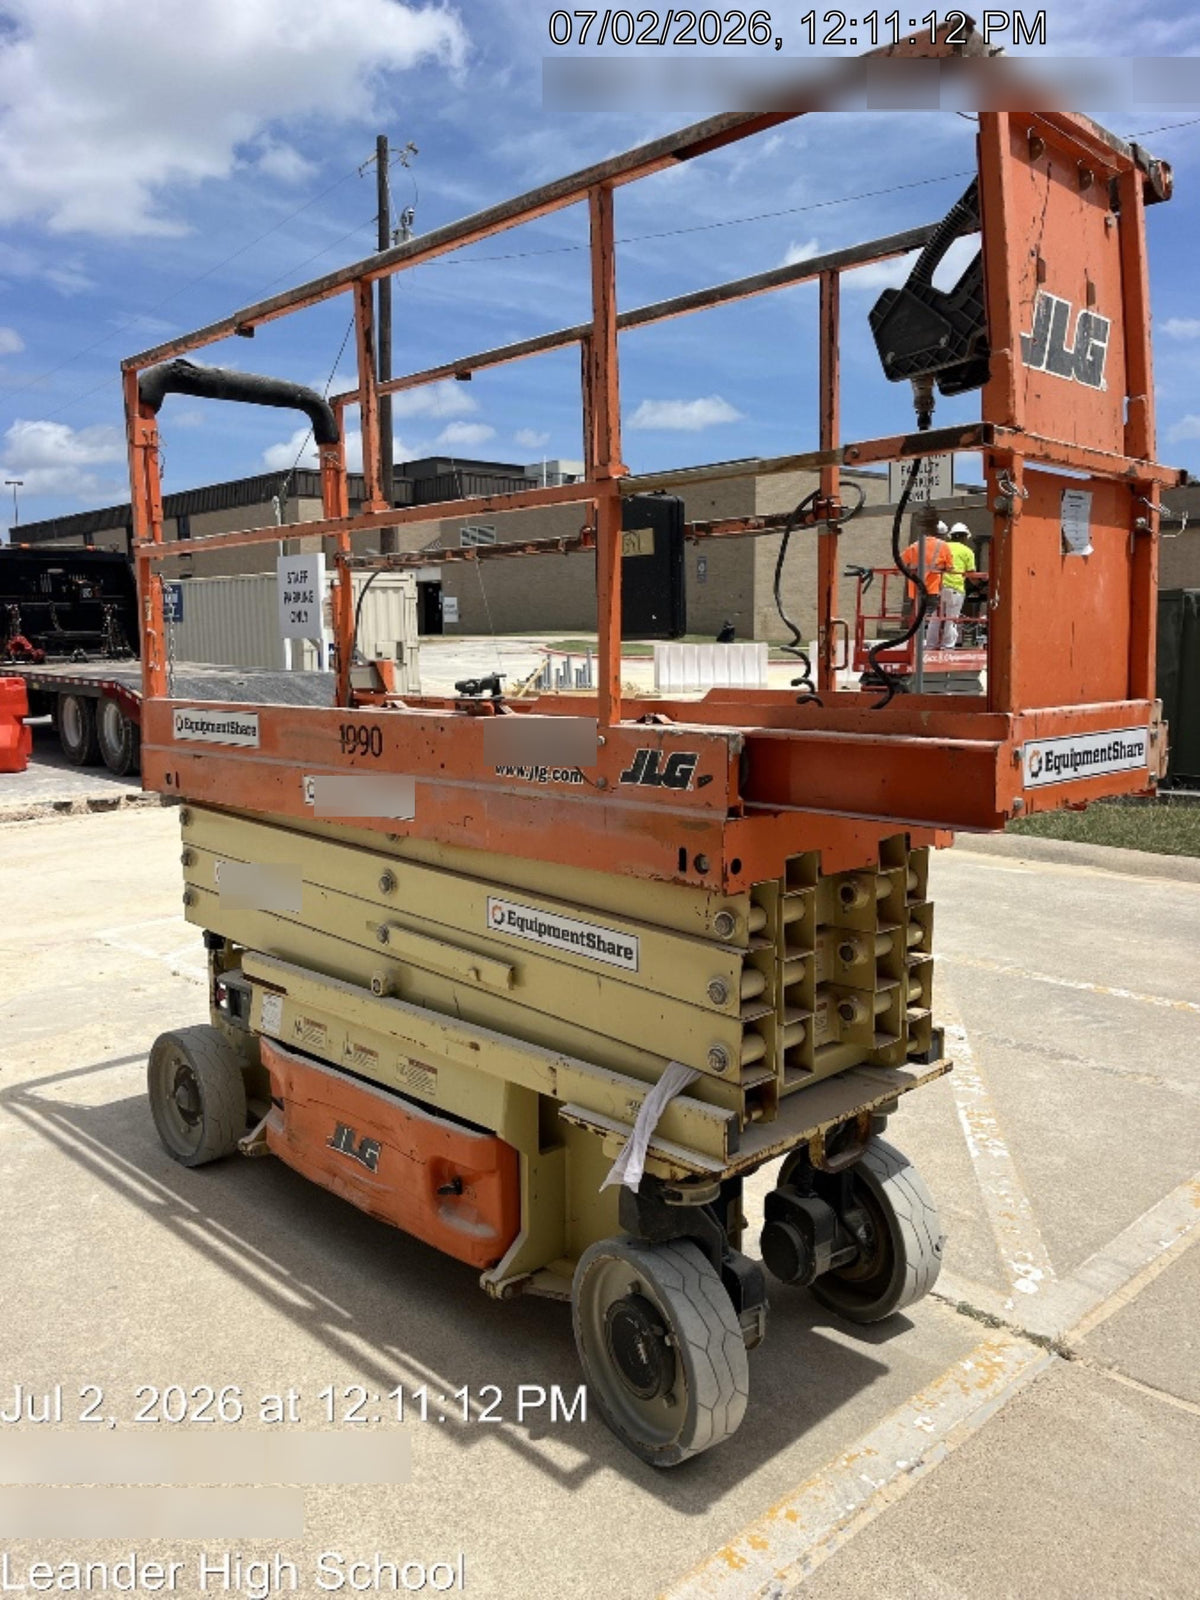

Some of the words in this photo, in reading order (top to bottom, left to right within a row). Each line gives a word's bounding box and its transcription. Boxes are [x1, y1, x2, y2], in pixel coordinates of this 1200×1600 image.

[1019, 289, 1110, 391] JLG
[185, 717, 257, 737] EquipmentShare
[339, 724, 383, 757] 1990
[495, 766, 584, 783] www.jlg.com
[619, 748, 700, 790] JLG
[1044, 741, 1144, 776] EquipmentShare
[507, 909, 634, 961] EquipmentShare
[326, 1123, 382, 1174] JLG
